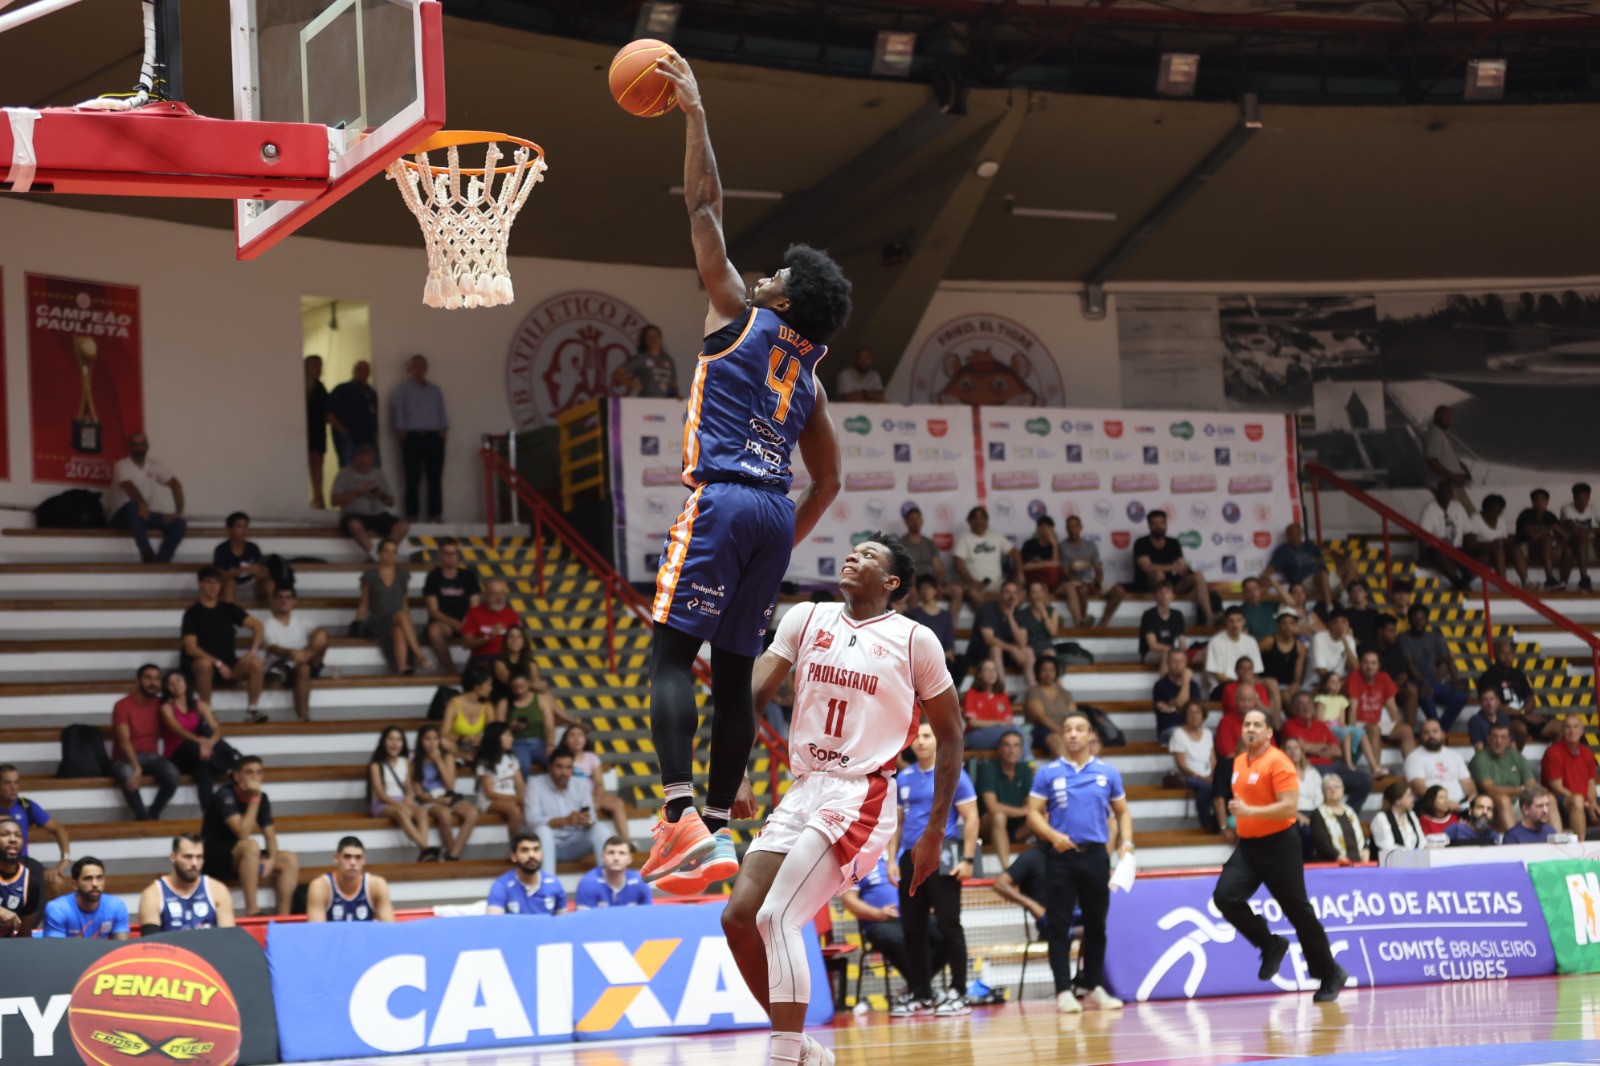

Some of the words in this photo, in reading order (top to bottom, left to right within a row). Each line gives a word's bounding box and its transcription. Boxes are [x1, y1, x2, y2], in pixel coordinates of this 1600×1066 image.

[36, 304, 131, 326] CAMPEÃO
[36, 317, 130, 338] PAULISTA
[778, 324, 814, 356] DELPH
[765, 344, 800, 425] 4
[65, 460, 111, 480] 2023
[701, 600, 715, 609] PRO
[807, 662, 879, 695] PAULISTANO
[824, 698, 848, 738] 11
[1247, 889, 1386, 924] FOAÇÃO
[1389, 891, 1422, 915] DE
[1426, 891, 1523, 915] ATLETAS
[1378, 936, 1449, 961] COMITÊ
[1450, 940, 1537, 958] BRASILEIRO
[1423, 964, 1437, 977] DE
[1438, 960, 1508, 980] CLUBES
[92, 973, 219, 1007] PENALTY
[349, 936, 770, 1053] CAIXA
[93, 1031, 142, 1050] CROSS
[169, 1043, 212, 1054] OVER
